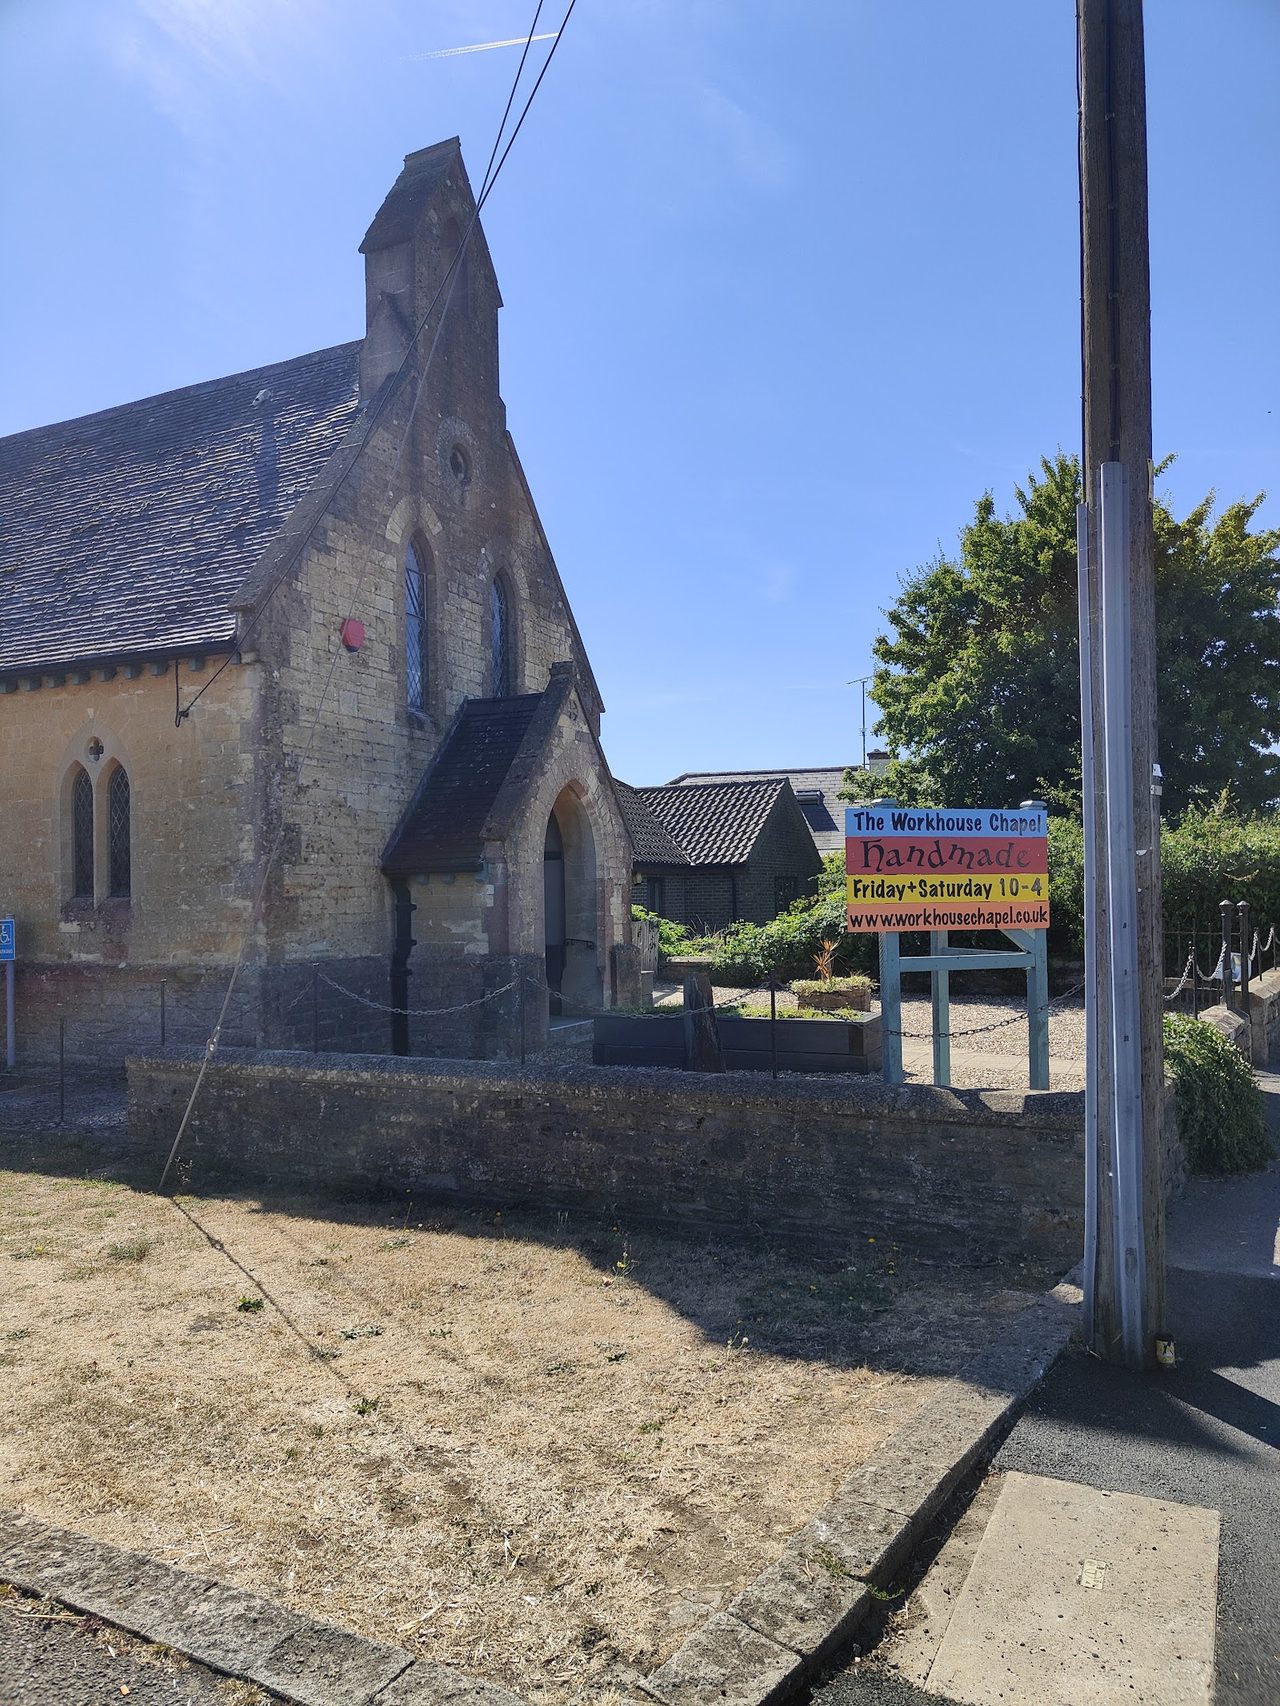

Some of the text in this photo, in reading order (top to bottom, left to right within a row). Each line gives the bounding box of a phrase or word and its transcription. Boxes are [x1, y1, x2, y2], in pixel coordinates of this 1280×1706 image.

[854, 812, 1041, 836] The Workhouse Chapel
[999, 878, 1042, 897] 10-4
[850, 906, 1048, 928] www.workhousechapel.co.uk
